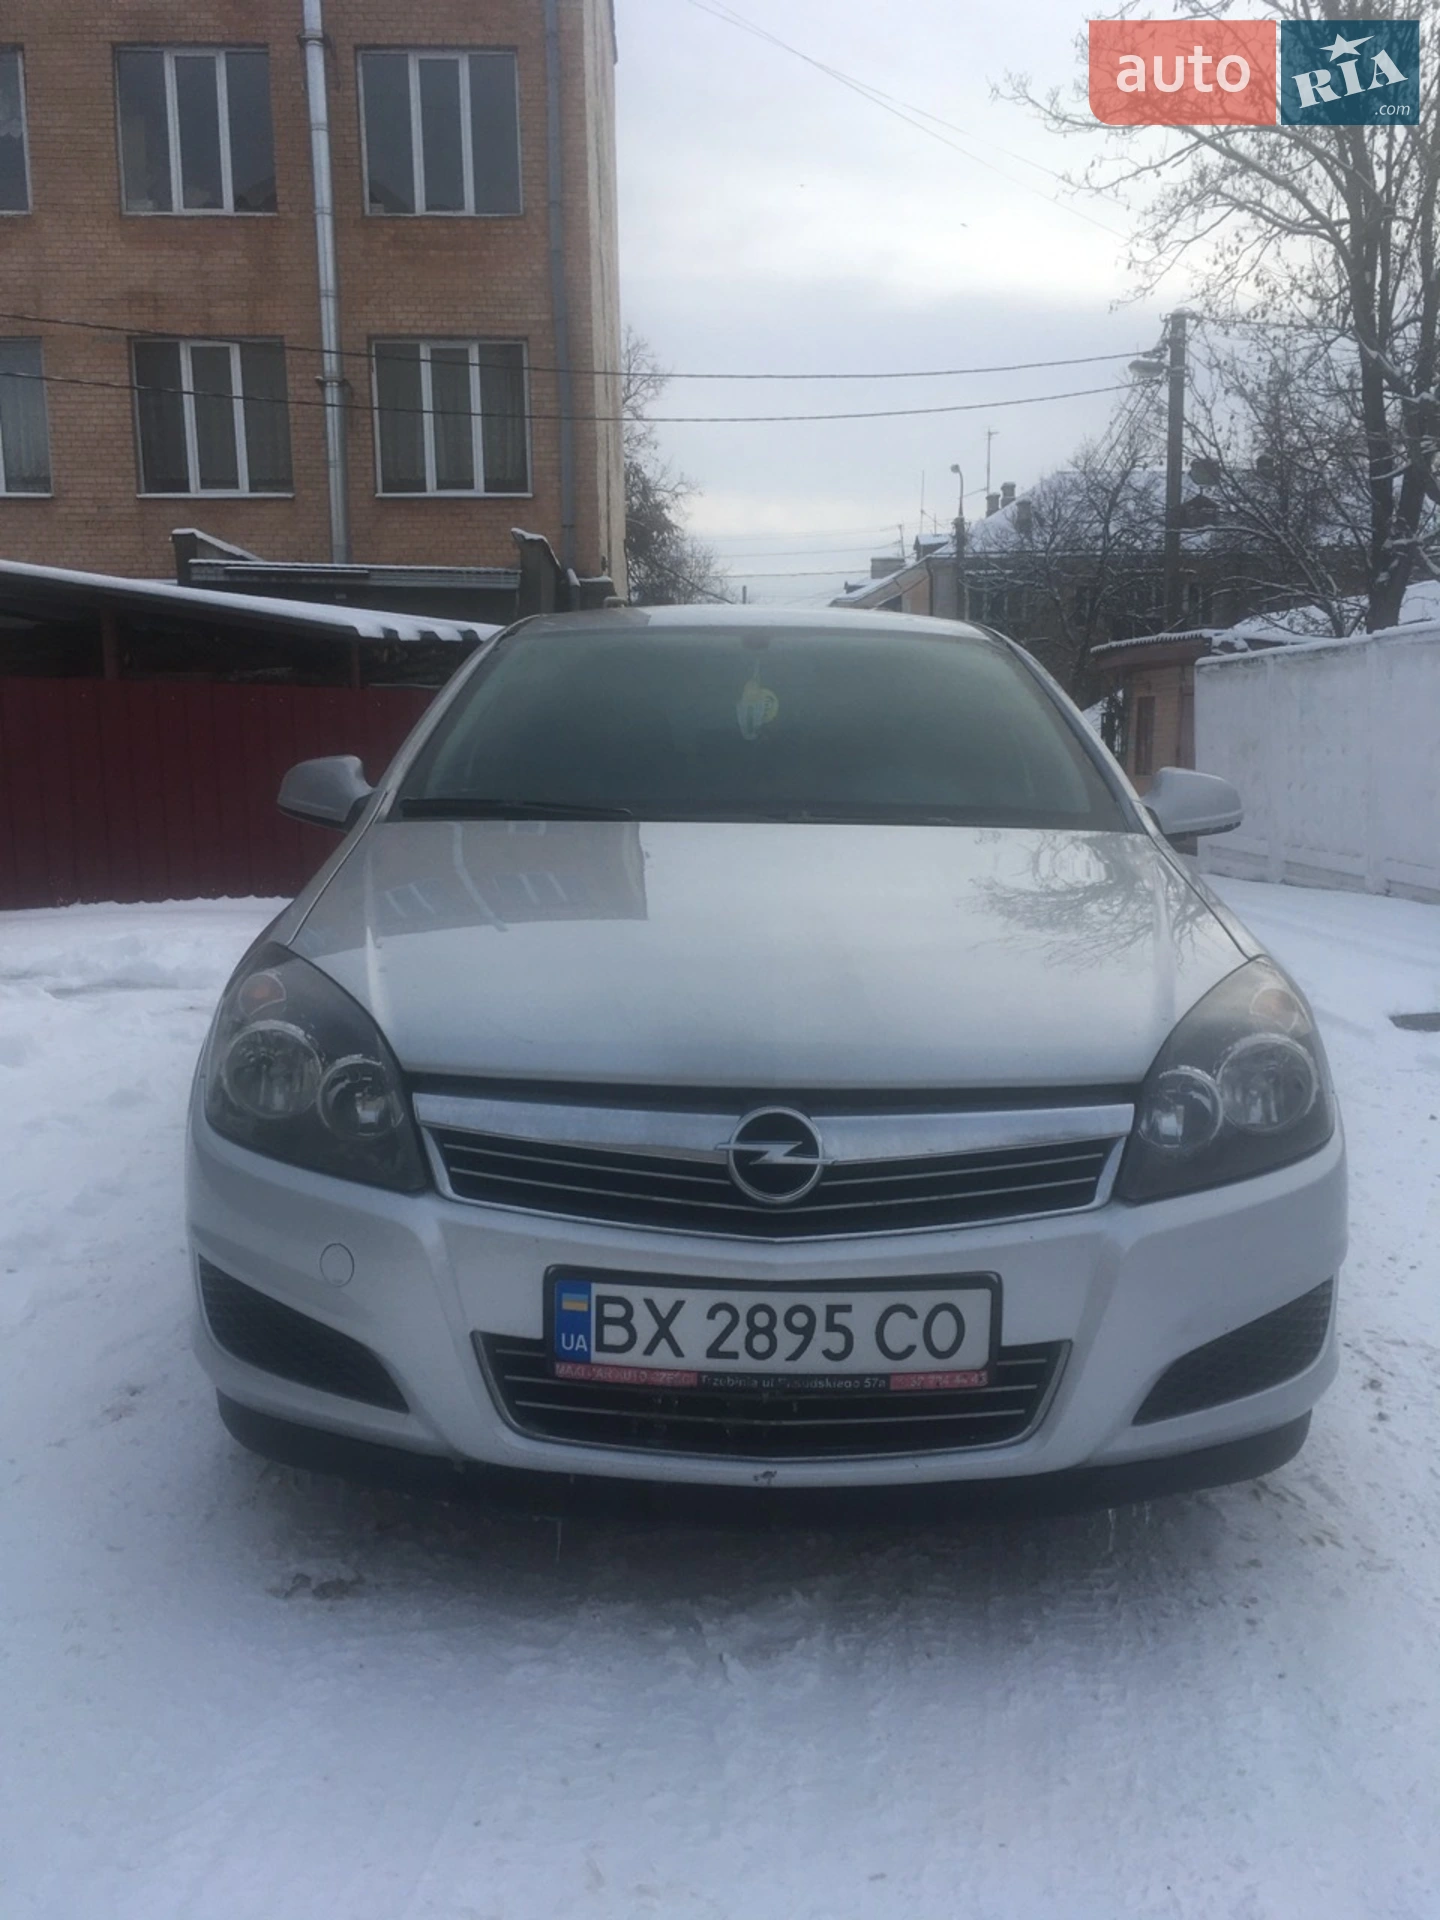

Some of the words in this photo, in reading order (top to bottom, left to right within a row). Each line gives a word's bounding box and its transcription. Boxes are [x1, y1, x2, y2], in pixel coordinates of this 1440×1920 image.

[561, 1333, 588, 1352] UA
[595, 1294, 686, 1358] BX
[706, 1302, 854, 1362] 2895
[875, 1302, 966, 1361] CO
